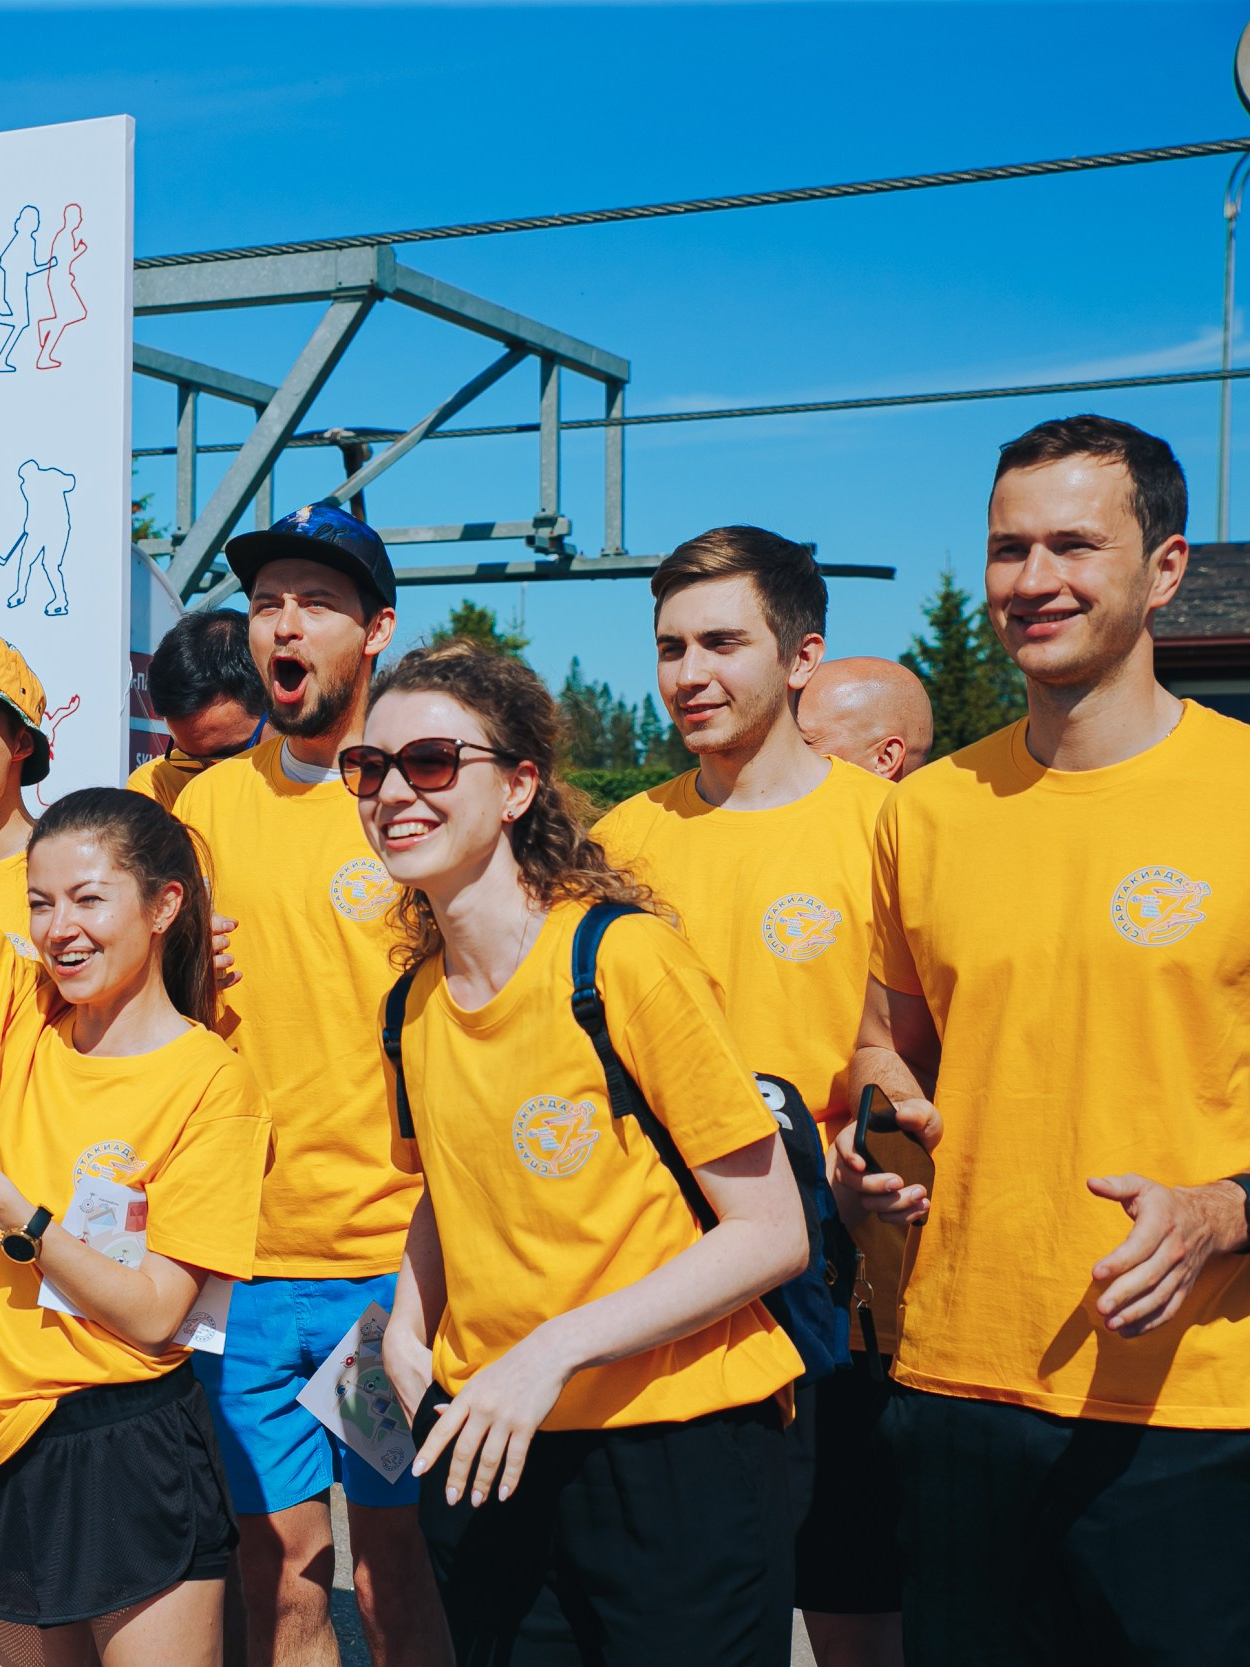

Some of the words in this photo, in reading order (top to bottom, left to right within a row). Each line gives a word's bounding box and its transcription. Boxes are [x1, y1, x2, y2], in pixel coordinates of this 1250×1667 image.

[333, 860, 382, 914] СПАРТАКИАДА
[1115, 869, 1183, 938] СПАРТАКИАДА
[765, 896, 822, 954] СПАРТАКИАДА
[76, 1144, 136, 1183] РТАКИАДА
[516, 1100, 567, 1173] СПАРТАКИАДА
